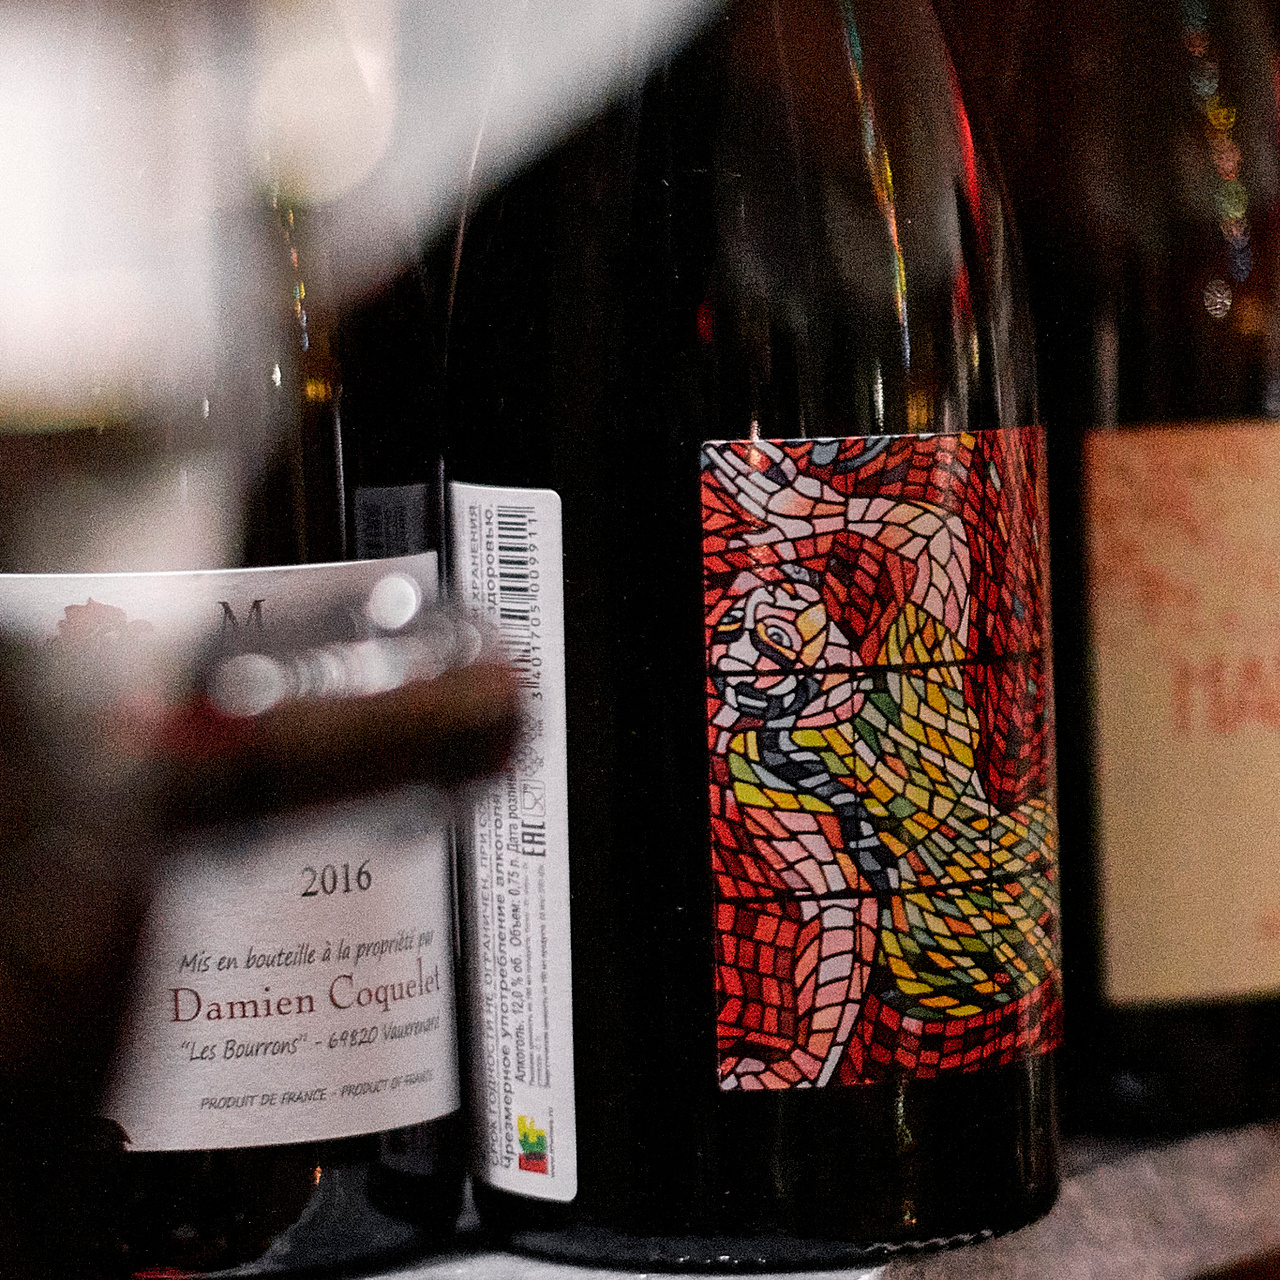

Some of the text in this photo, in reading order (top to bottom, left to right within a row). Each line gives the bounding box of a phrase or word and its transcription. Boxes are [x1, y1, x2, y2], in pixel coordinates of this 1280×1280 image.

[528, 517, 540, 592] 009911
[530, 605, 542, 679] 401705
[301, 859, 373, 898] 2016
[180, 950, 212, 973] Mis
[217, 956, 239, 971] en
[246, 943, 316, 970] bouteille
[338, 937, 351, 962] la
[168, 957, 441, 1022] Damien Coquelet
[329, 1025, 379, 1050] 69820
[200, 1093, 258, 1111] PRODUIT
[260, 1091, 277, 1106] DE
[281, 1087, 328, 1105] FRANCE
[499, 1045, 515, 1169] Чрезмерное
